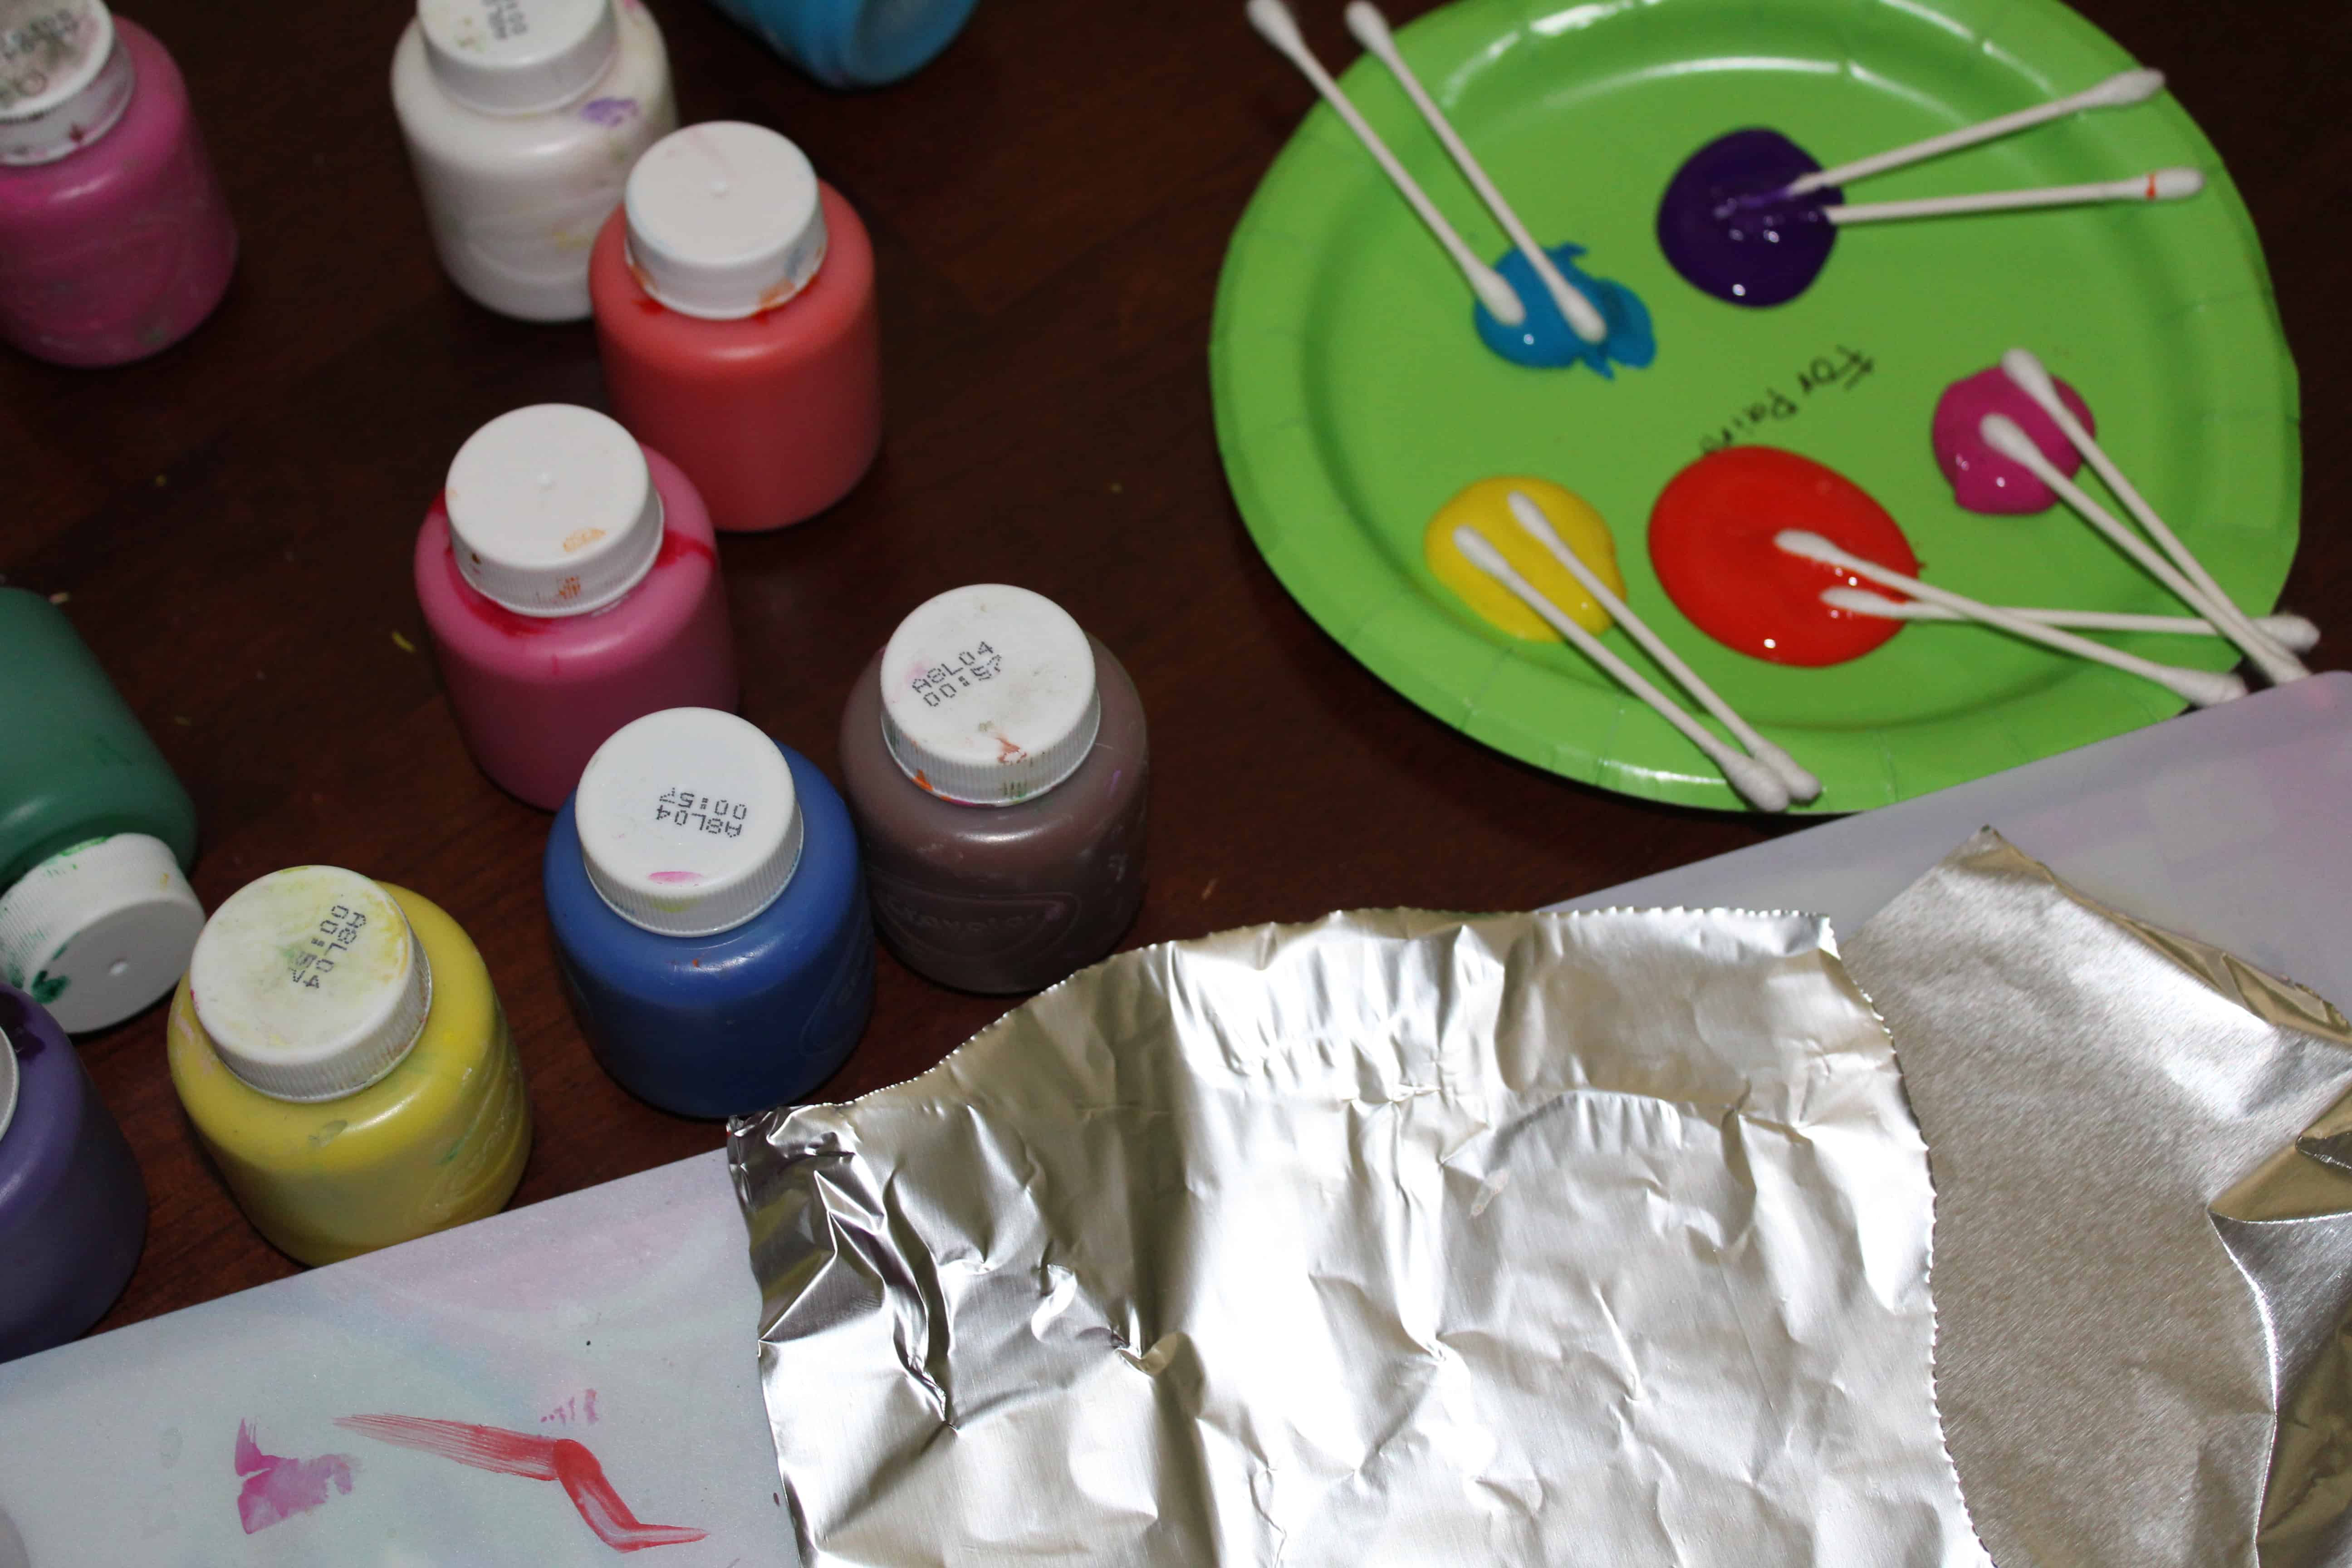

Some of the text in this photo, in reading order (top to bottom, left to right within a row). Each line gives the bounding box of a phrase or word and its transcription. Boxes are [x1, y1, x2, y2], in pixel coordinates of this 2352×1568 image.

[1797, 344, 1874, 397] For
[911, 641, 994, 693] A8L04
[656, 804, 742, 838] A8L04
[659, 787, 747, 820] 00:57
[303, 912, 367, 989] A8L04
